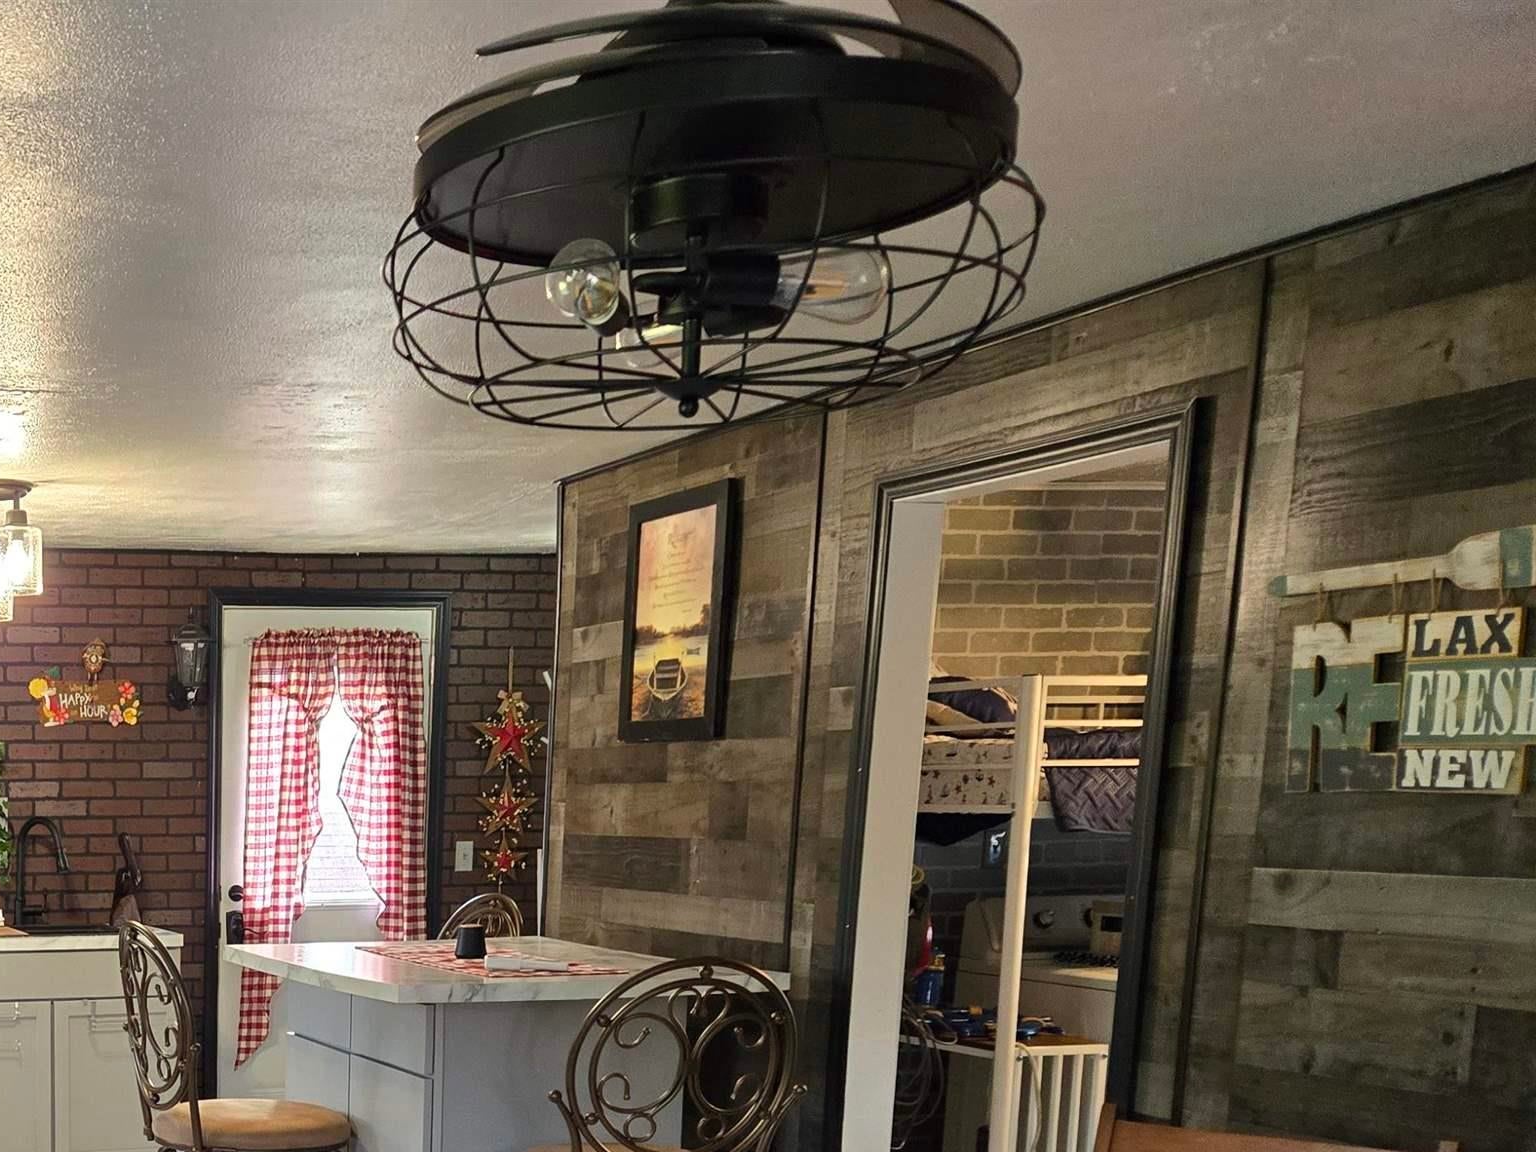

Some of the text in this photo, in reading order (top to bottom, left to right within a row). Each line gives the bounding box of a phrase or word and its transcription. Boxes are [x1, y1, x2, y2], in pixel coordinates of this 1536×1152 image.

[1412, 613, 1514, 656] LAX
[59, 692, 90, 709] HAPPY
[1286, 616, 1405, 792] RE
[1404, 667, 1536, 737] FRESH
[1401, 749, 1515, 788] NEW
